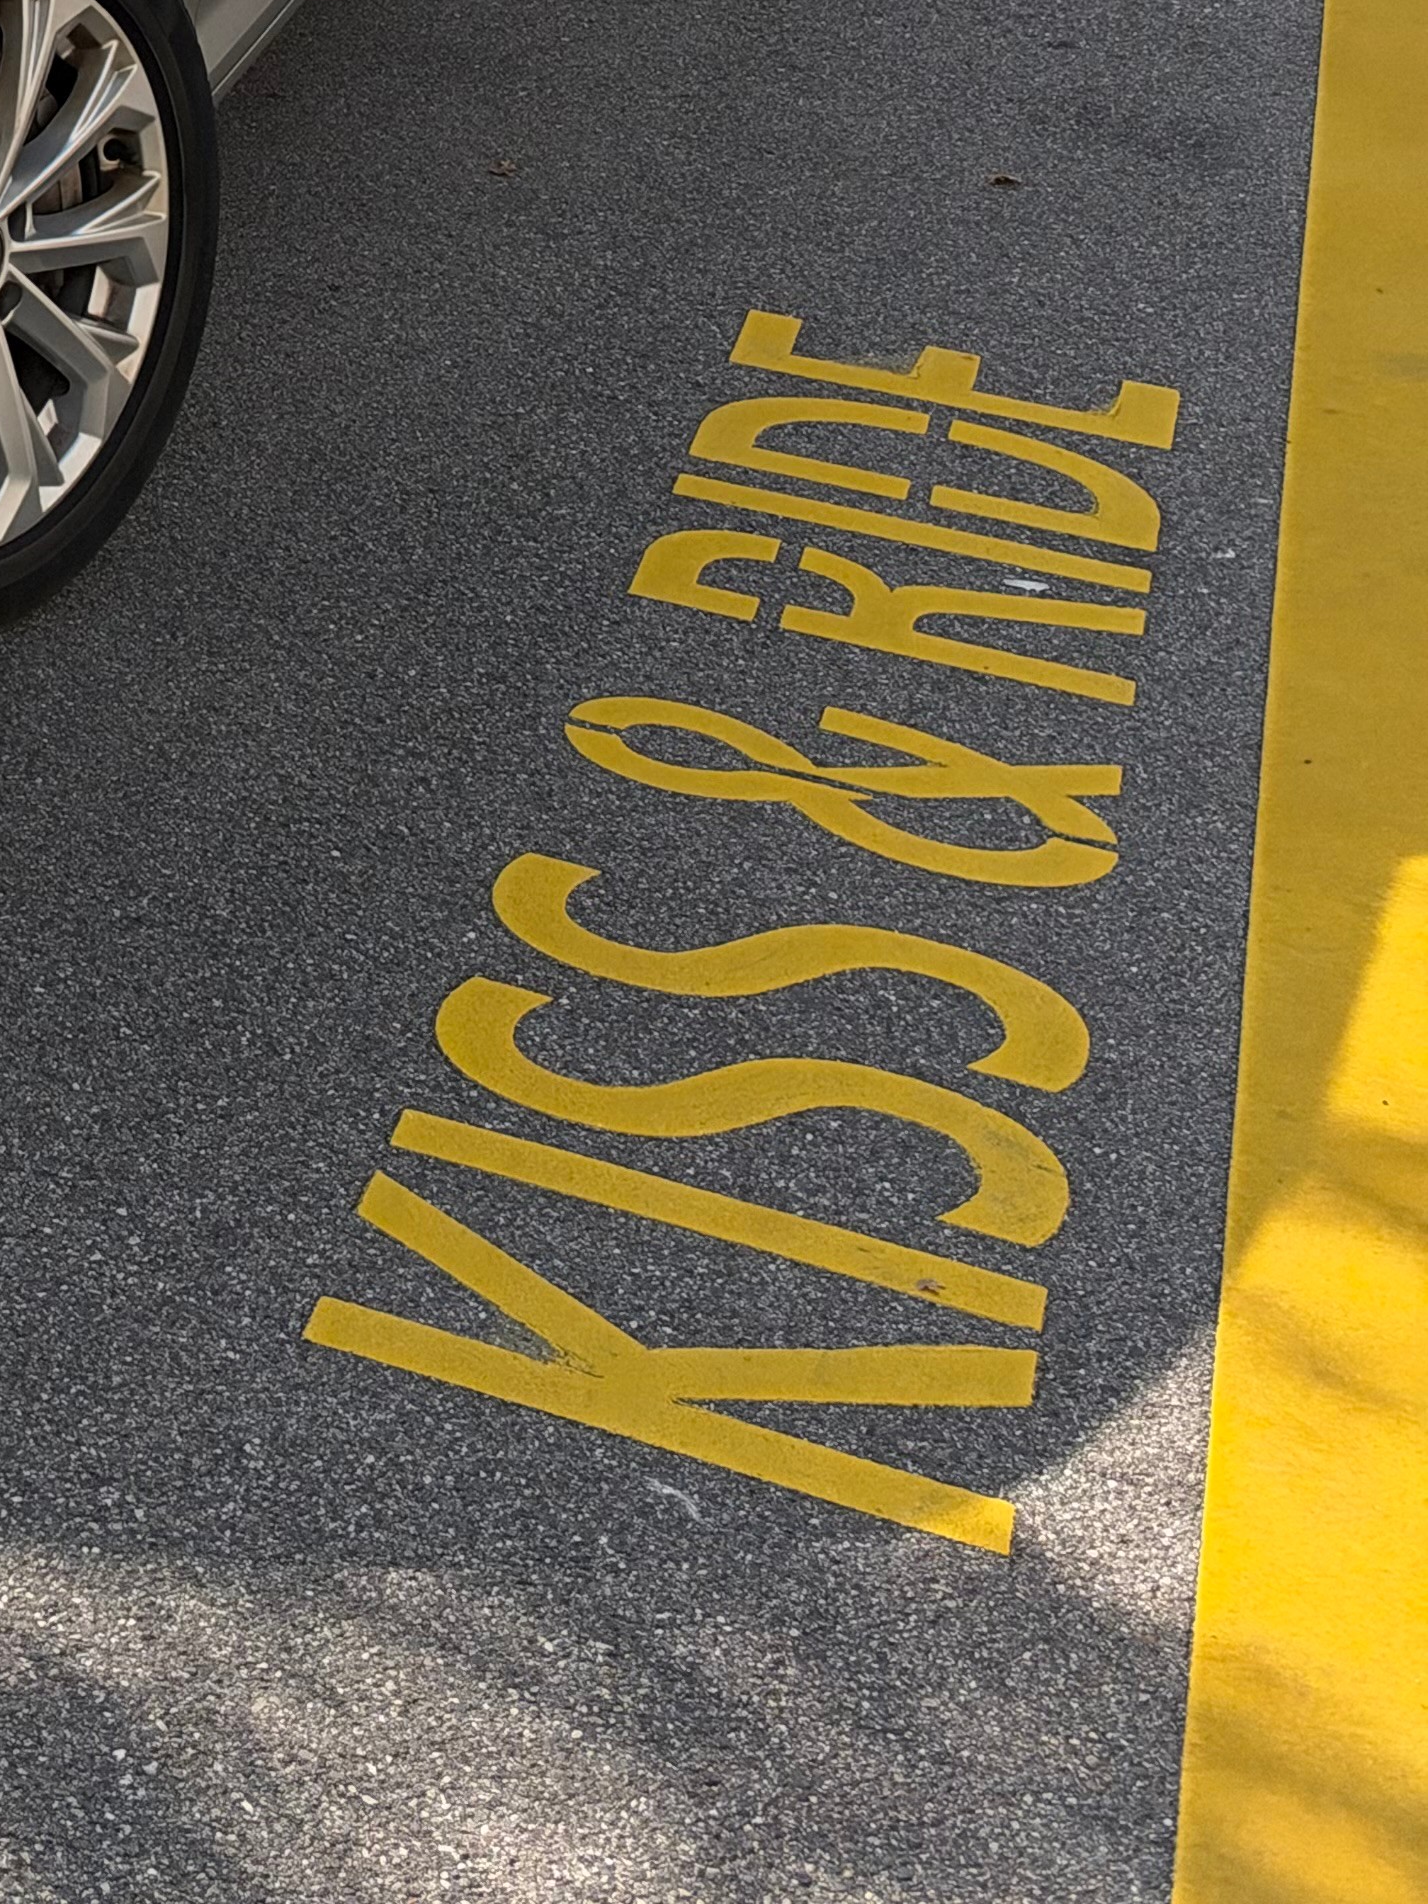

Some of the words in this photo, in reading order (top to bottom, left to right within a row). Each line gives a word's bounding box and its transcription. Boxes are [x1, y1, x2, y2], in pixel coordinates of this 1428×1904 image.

[629, 310, 1181, 706] RIDE
[565, 696, 1124, 888] &
[302, 852, 1091, 1557] KISS
